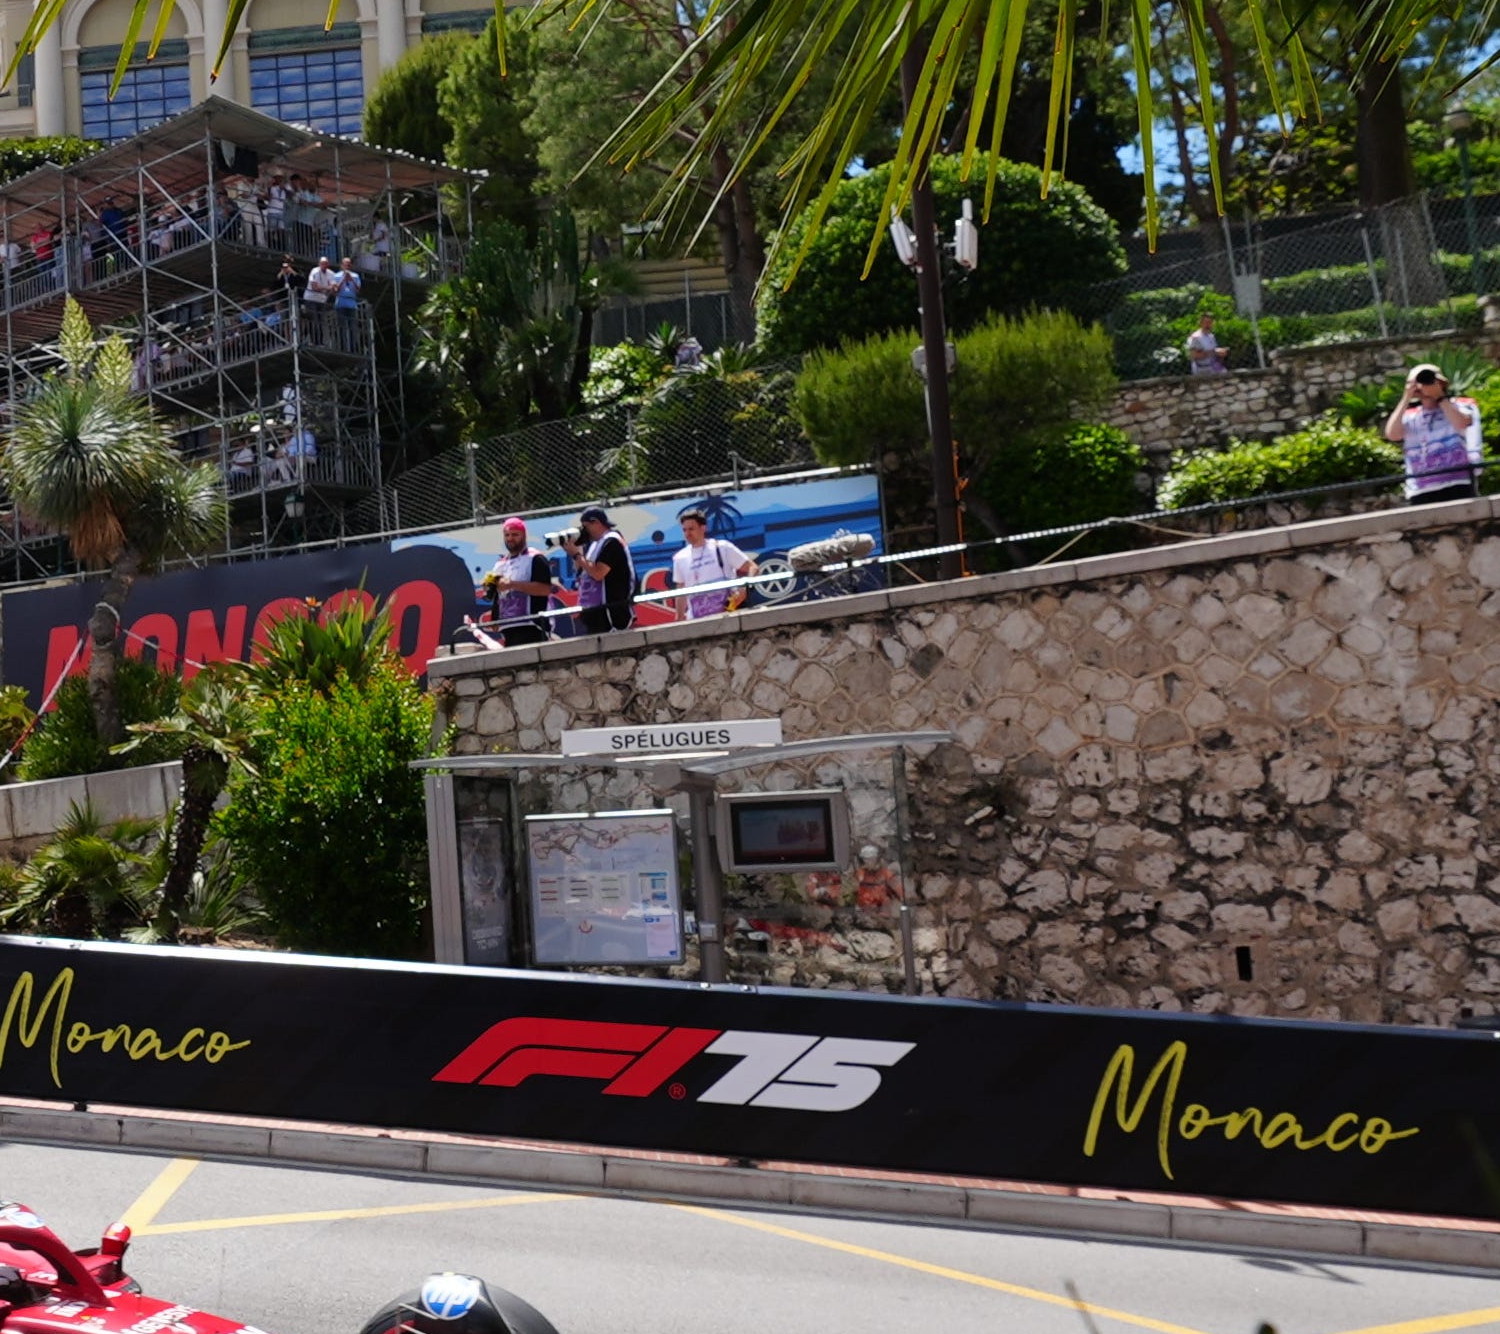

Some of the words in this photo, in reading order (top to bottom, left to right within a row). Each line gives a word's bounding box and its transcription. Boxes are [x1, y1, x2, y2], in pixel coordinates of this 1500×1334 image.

[610, 729, 731, 750] SPÉLUGUES
[431, 1017, 722, 1097] F1
[696, 1031, 917, 1112] 75
[1082, 1039, 1420, 1180] Monaco
